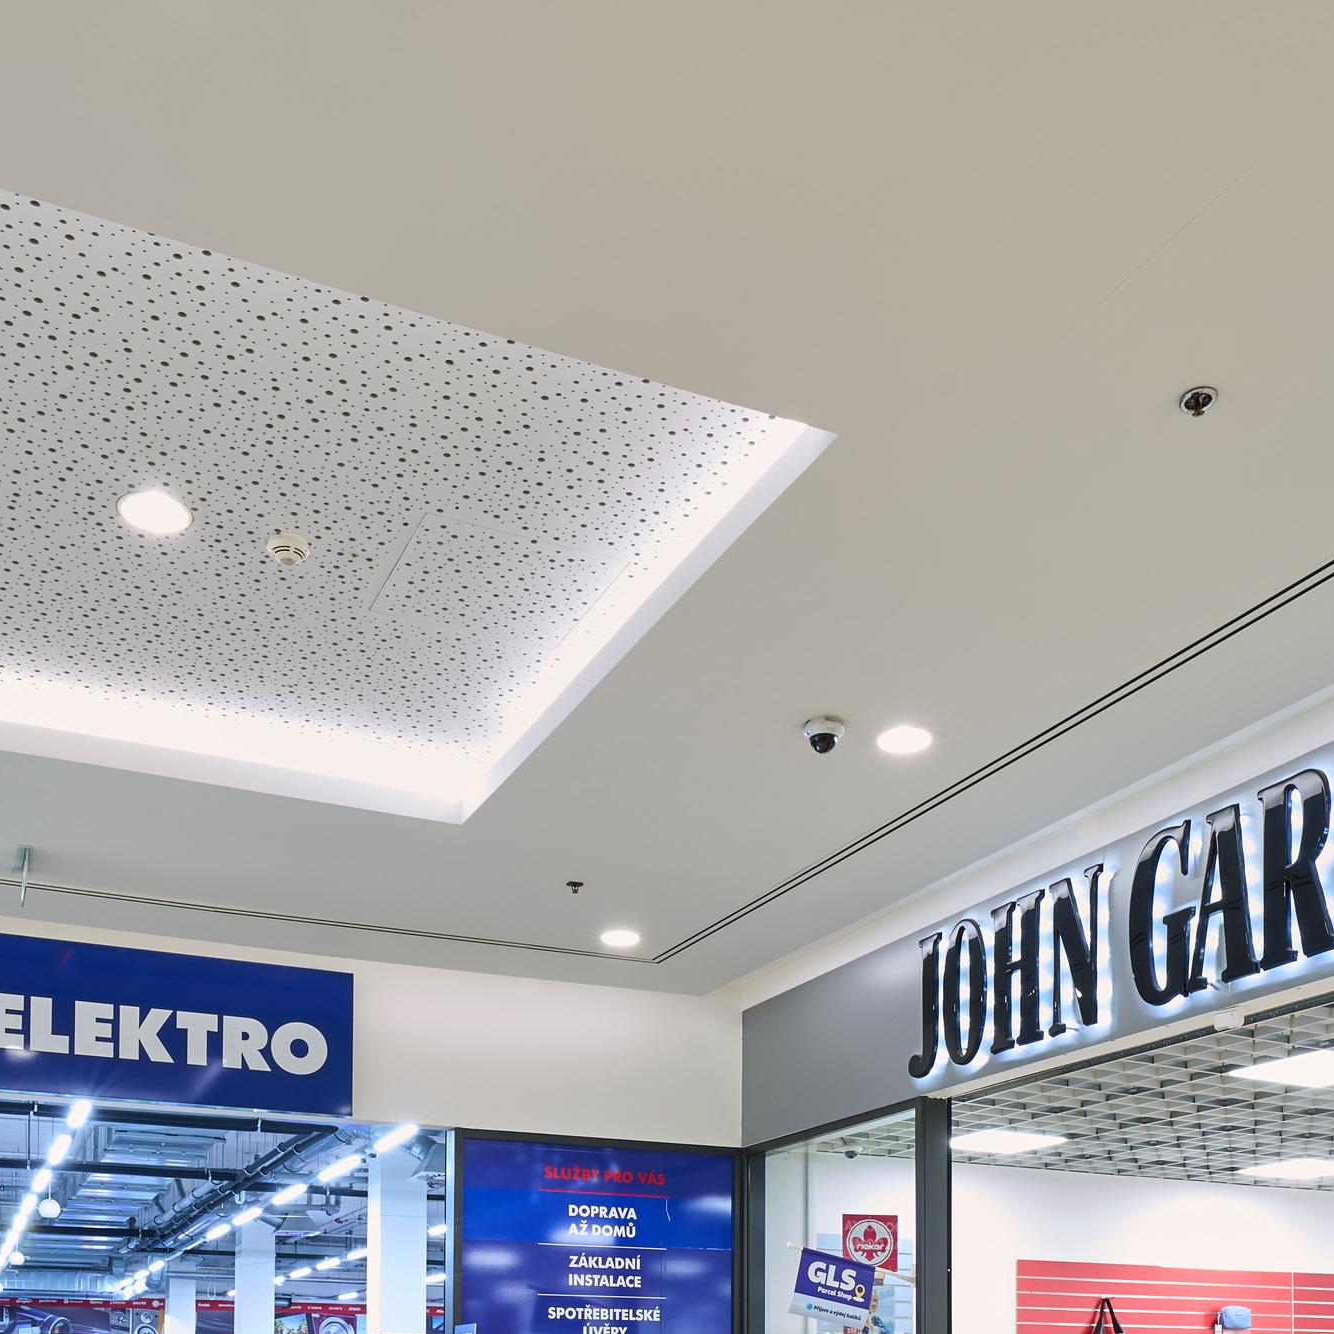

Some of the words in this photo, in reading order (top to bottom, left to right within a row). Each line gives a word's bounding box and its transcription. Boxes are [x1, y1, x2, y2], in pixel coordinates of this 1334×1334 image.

[909, 863, 1103, 1079] JOHN
[544, 1165, 598, 1181] SLUŽBY
[603, 1170, 633, 1183] PRO
[638, 1169, 665, 1185] VÁS
[568, 1204, 637, 1220] DOPRAVA
[568, 1220, 588, 1236] AŽ
[592, 1222, 636, 1238] DOMŮ
[568, 1253, 641, 1270] ZÁKLADNÍ
[568, 1274, 641, 1288] INSTALACE
[807, 1260, 856, 1292] GLS
[817, 1286, 837, 1296] Parcel
[837, 1290, 853, 1301] Shop
[547, 1304, 660, 1321] SPOTŘEBITELSKÉ
